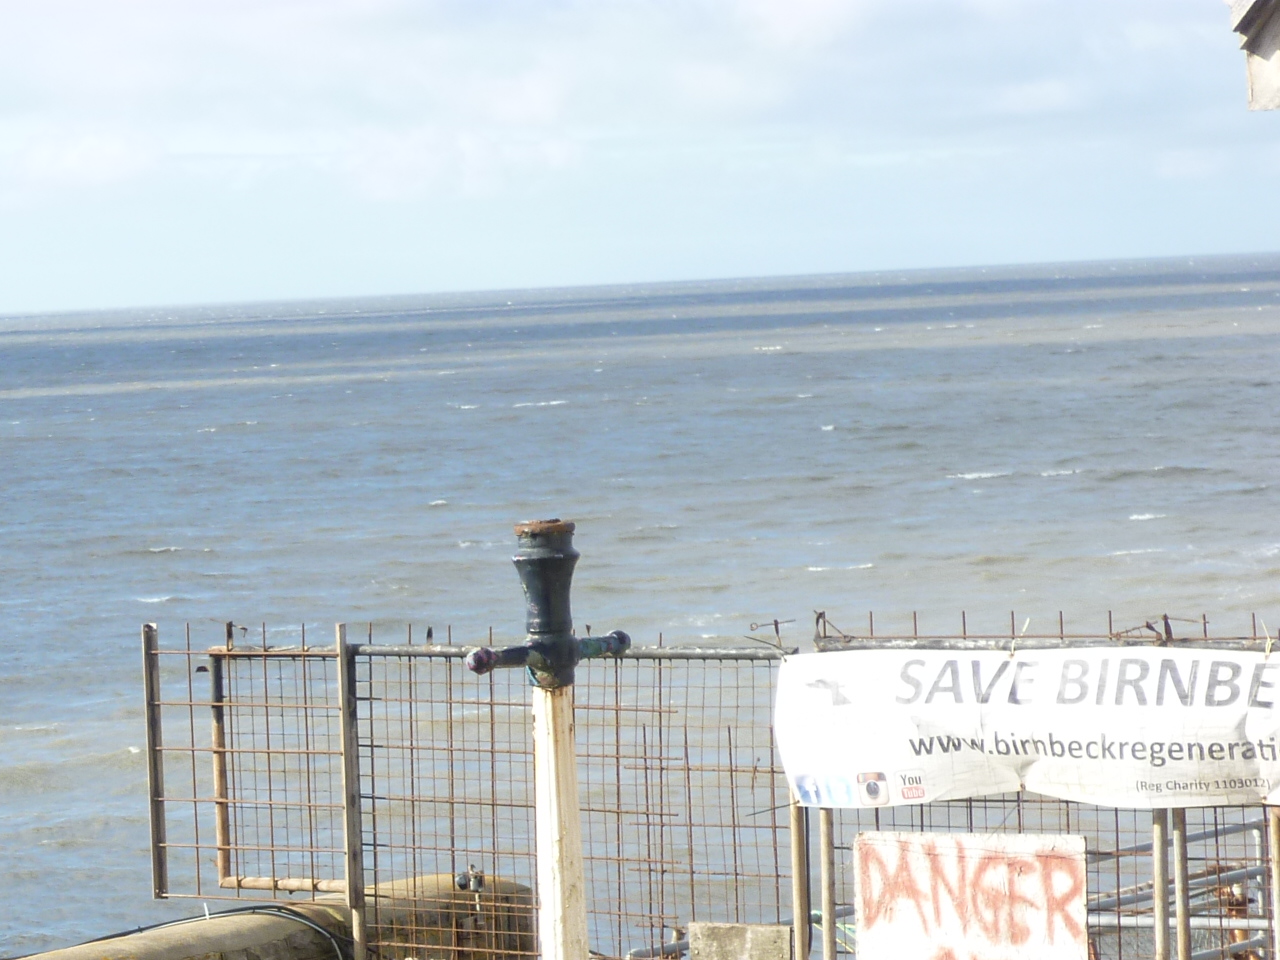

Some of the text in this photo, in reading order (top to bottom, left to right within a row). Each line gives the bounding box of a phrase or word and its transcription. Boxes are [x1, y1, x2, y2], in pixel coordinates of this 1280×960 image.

[895, 658, 1039, 706] SAVE
[908, 731, 1280, 767] www.birnbeckregenerati
[900, 774, 922, 786] You
[1136, 779, 1162, 793] (Reg
[1166, 779, 1210, 792] Charity
[903, 787, 924, 799] Tube
[857, 836, 1085, 945] DANGER
